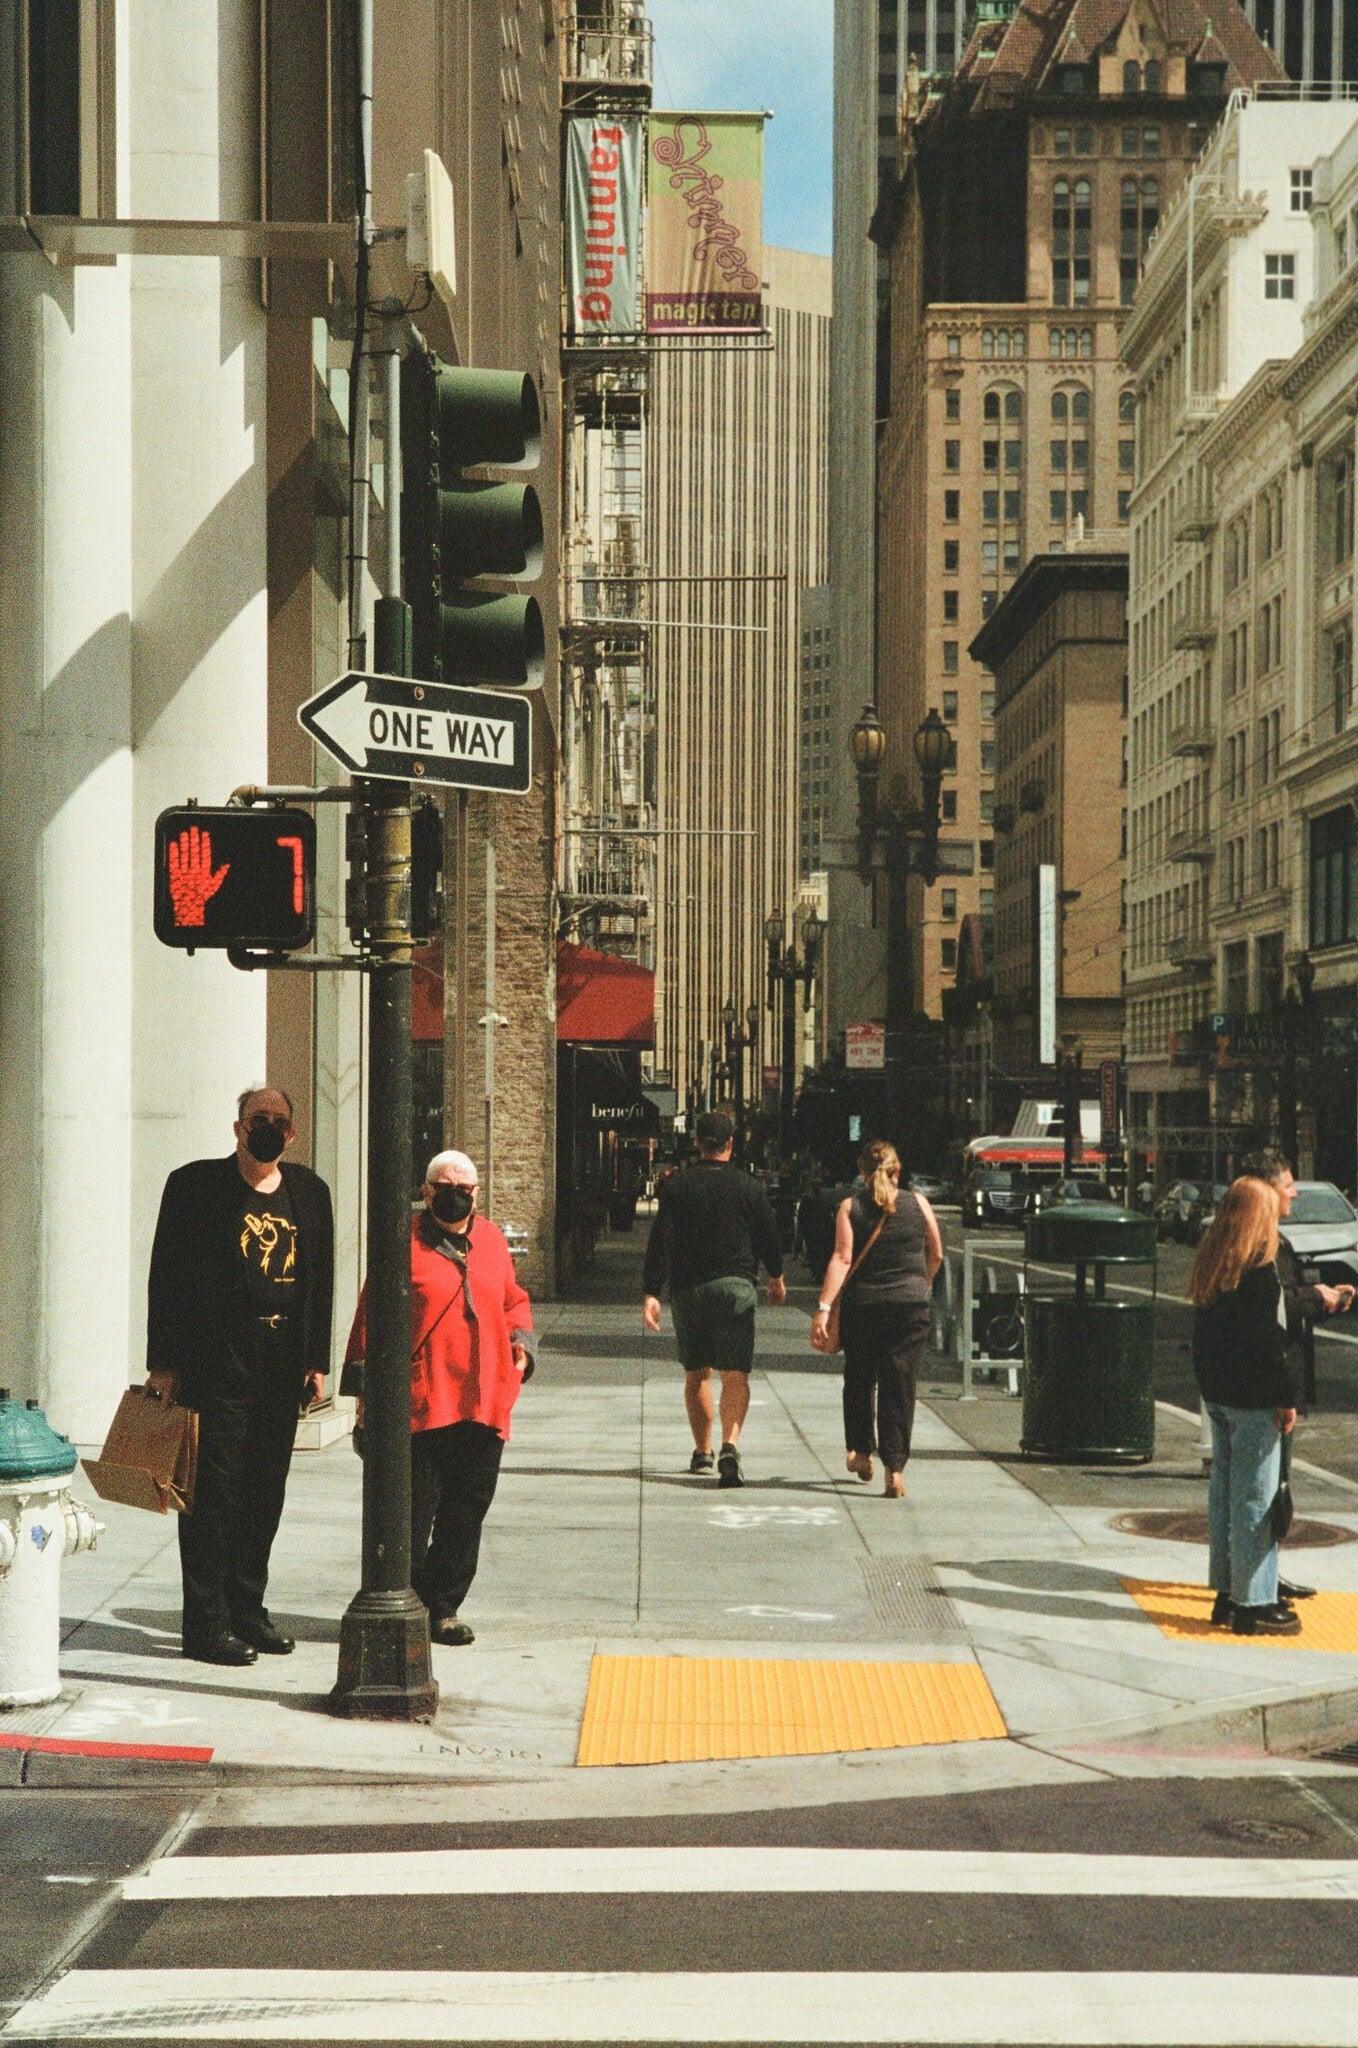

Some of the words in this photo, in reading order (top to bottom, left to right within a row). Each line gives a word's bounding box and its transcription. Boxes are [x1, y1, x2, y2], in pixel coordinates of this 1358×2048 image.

[653, 302, 716, 325] magic
[722, 301, 756, 320] tan
[368, 707, 433, 751] ONE
[446, 718, 506, 760] WAY
[276, 836, 304, 915] 7
[1213, 1016, 1224, 1031] P
